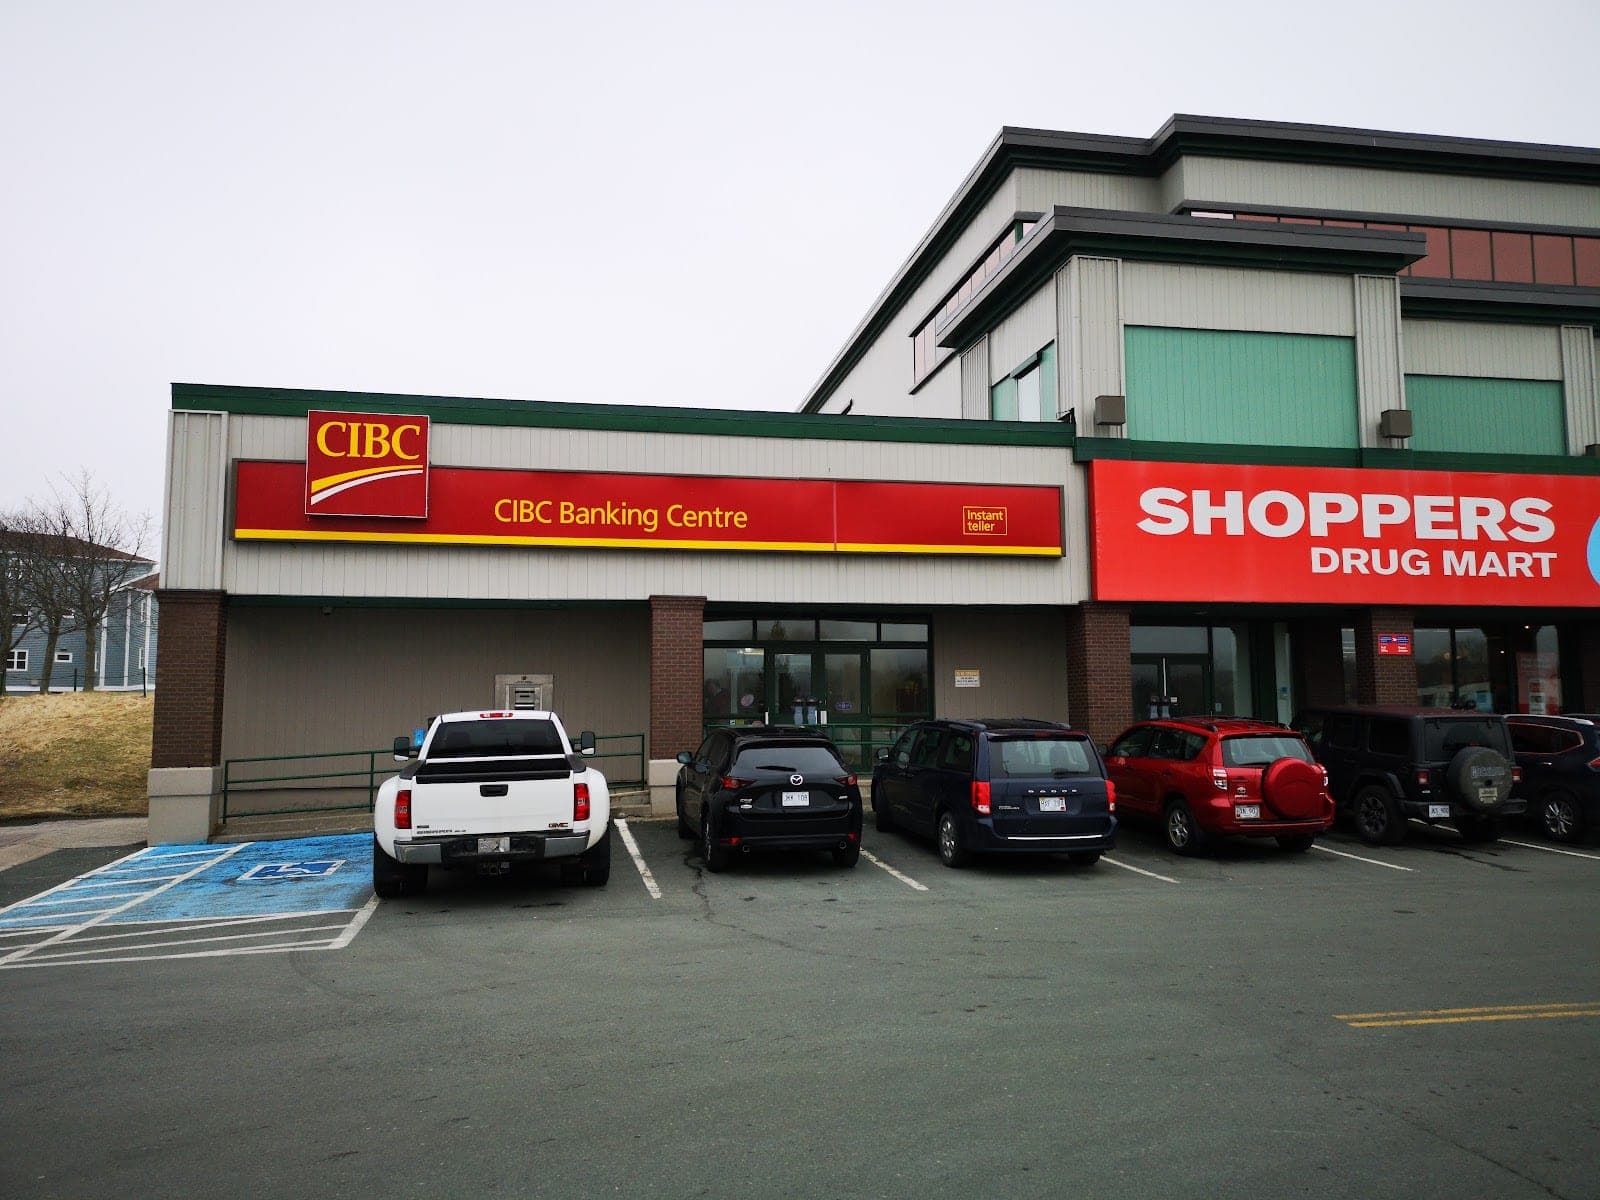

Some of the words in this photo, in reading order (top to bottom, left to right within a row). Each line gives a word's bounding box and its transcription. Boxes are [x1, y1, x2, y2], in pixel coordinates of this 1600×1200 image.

[316, 421, 421, 460] CIBC
[494, 498, 553, 525] CIBC
[559, 500, 660, 534] Banking
[666, 504, 748, 529] Centre
[967, 509, 1005, 521] Instant
[967, 520, 996, 532] teller
[1136, 487, 1555, 543] SHOPPERS
[1310, 546, 1430, 576] DRUG
[1442, 550, 1558, 578] MART
